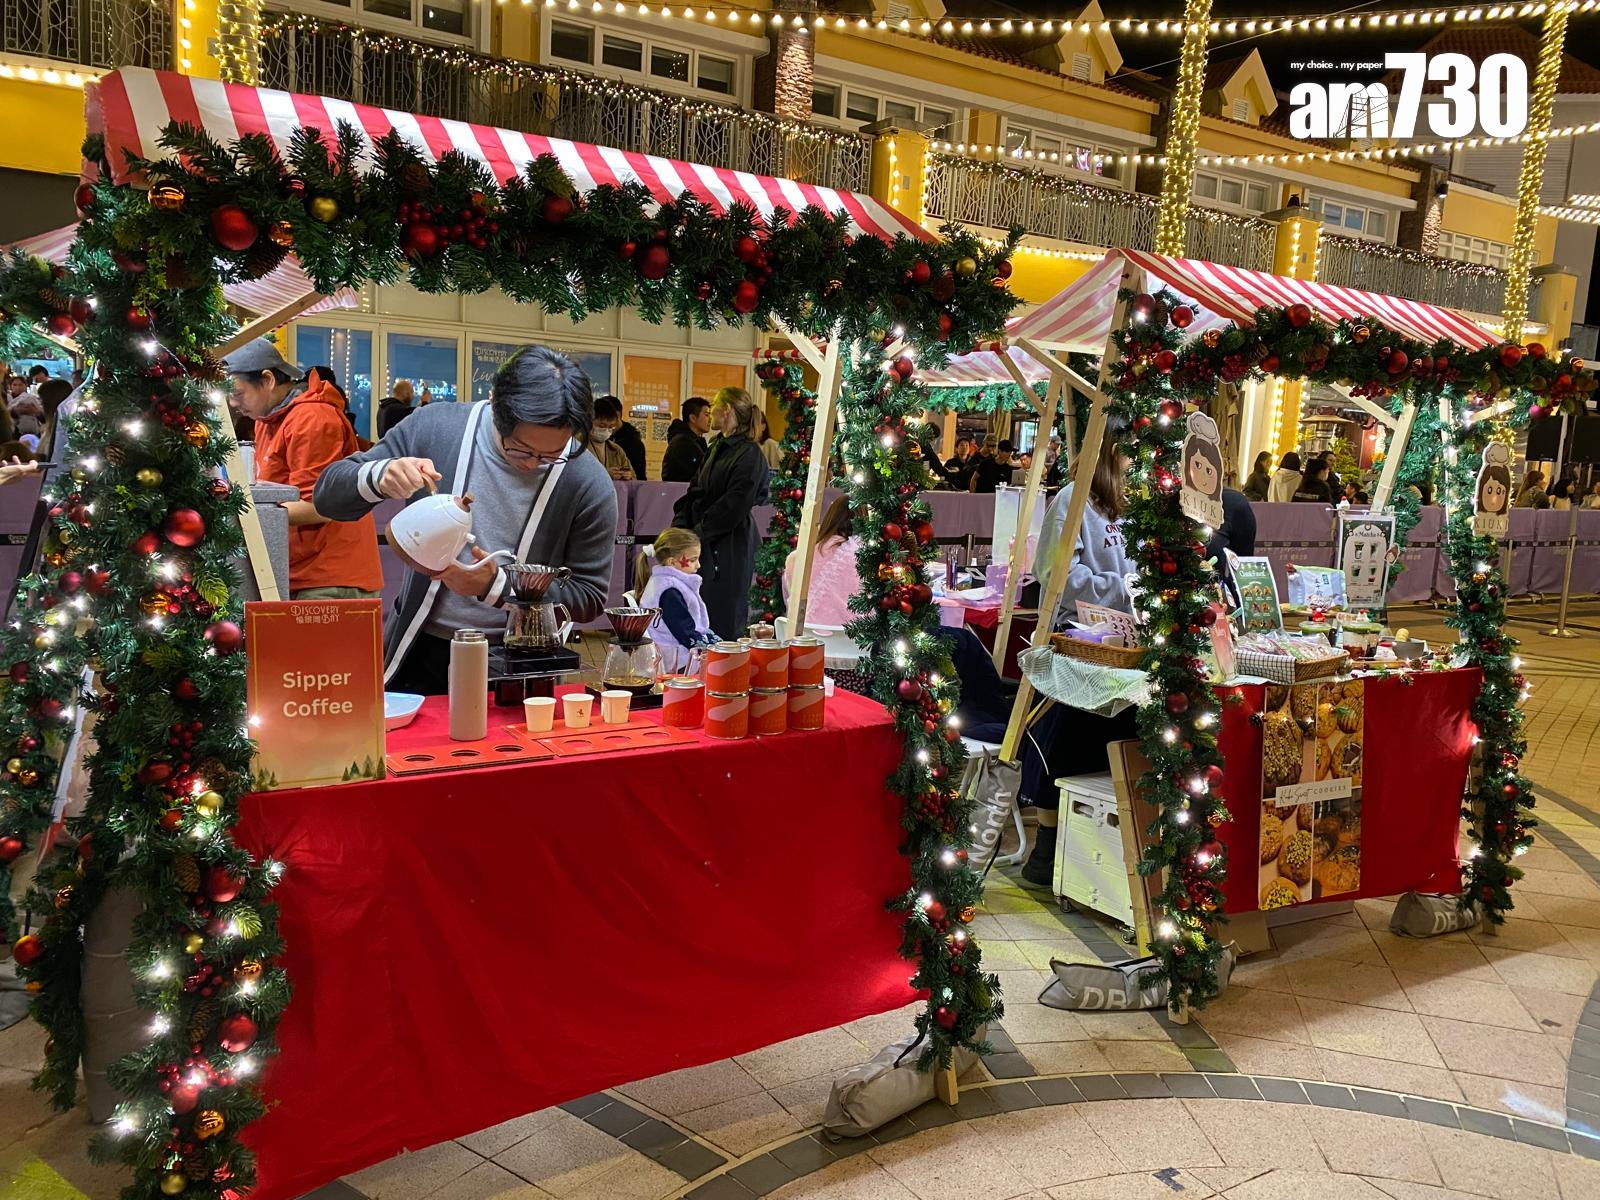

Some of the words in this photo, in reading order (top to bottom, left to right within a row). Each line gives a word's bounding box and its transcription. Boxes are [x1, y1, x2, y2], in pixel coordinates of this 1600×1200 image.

[282, 671, 352, 692] Sipper
[282, 698, 353, 718] Coffee
[1313, 784, 1346, 796] COOKIES
